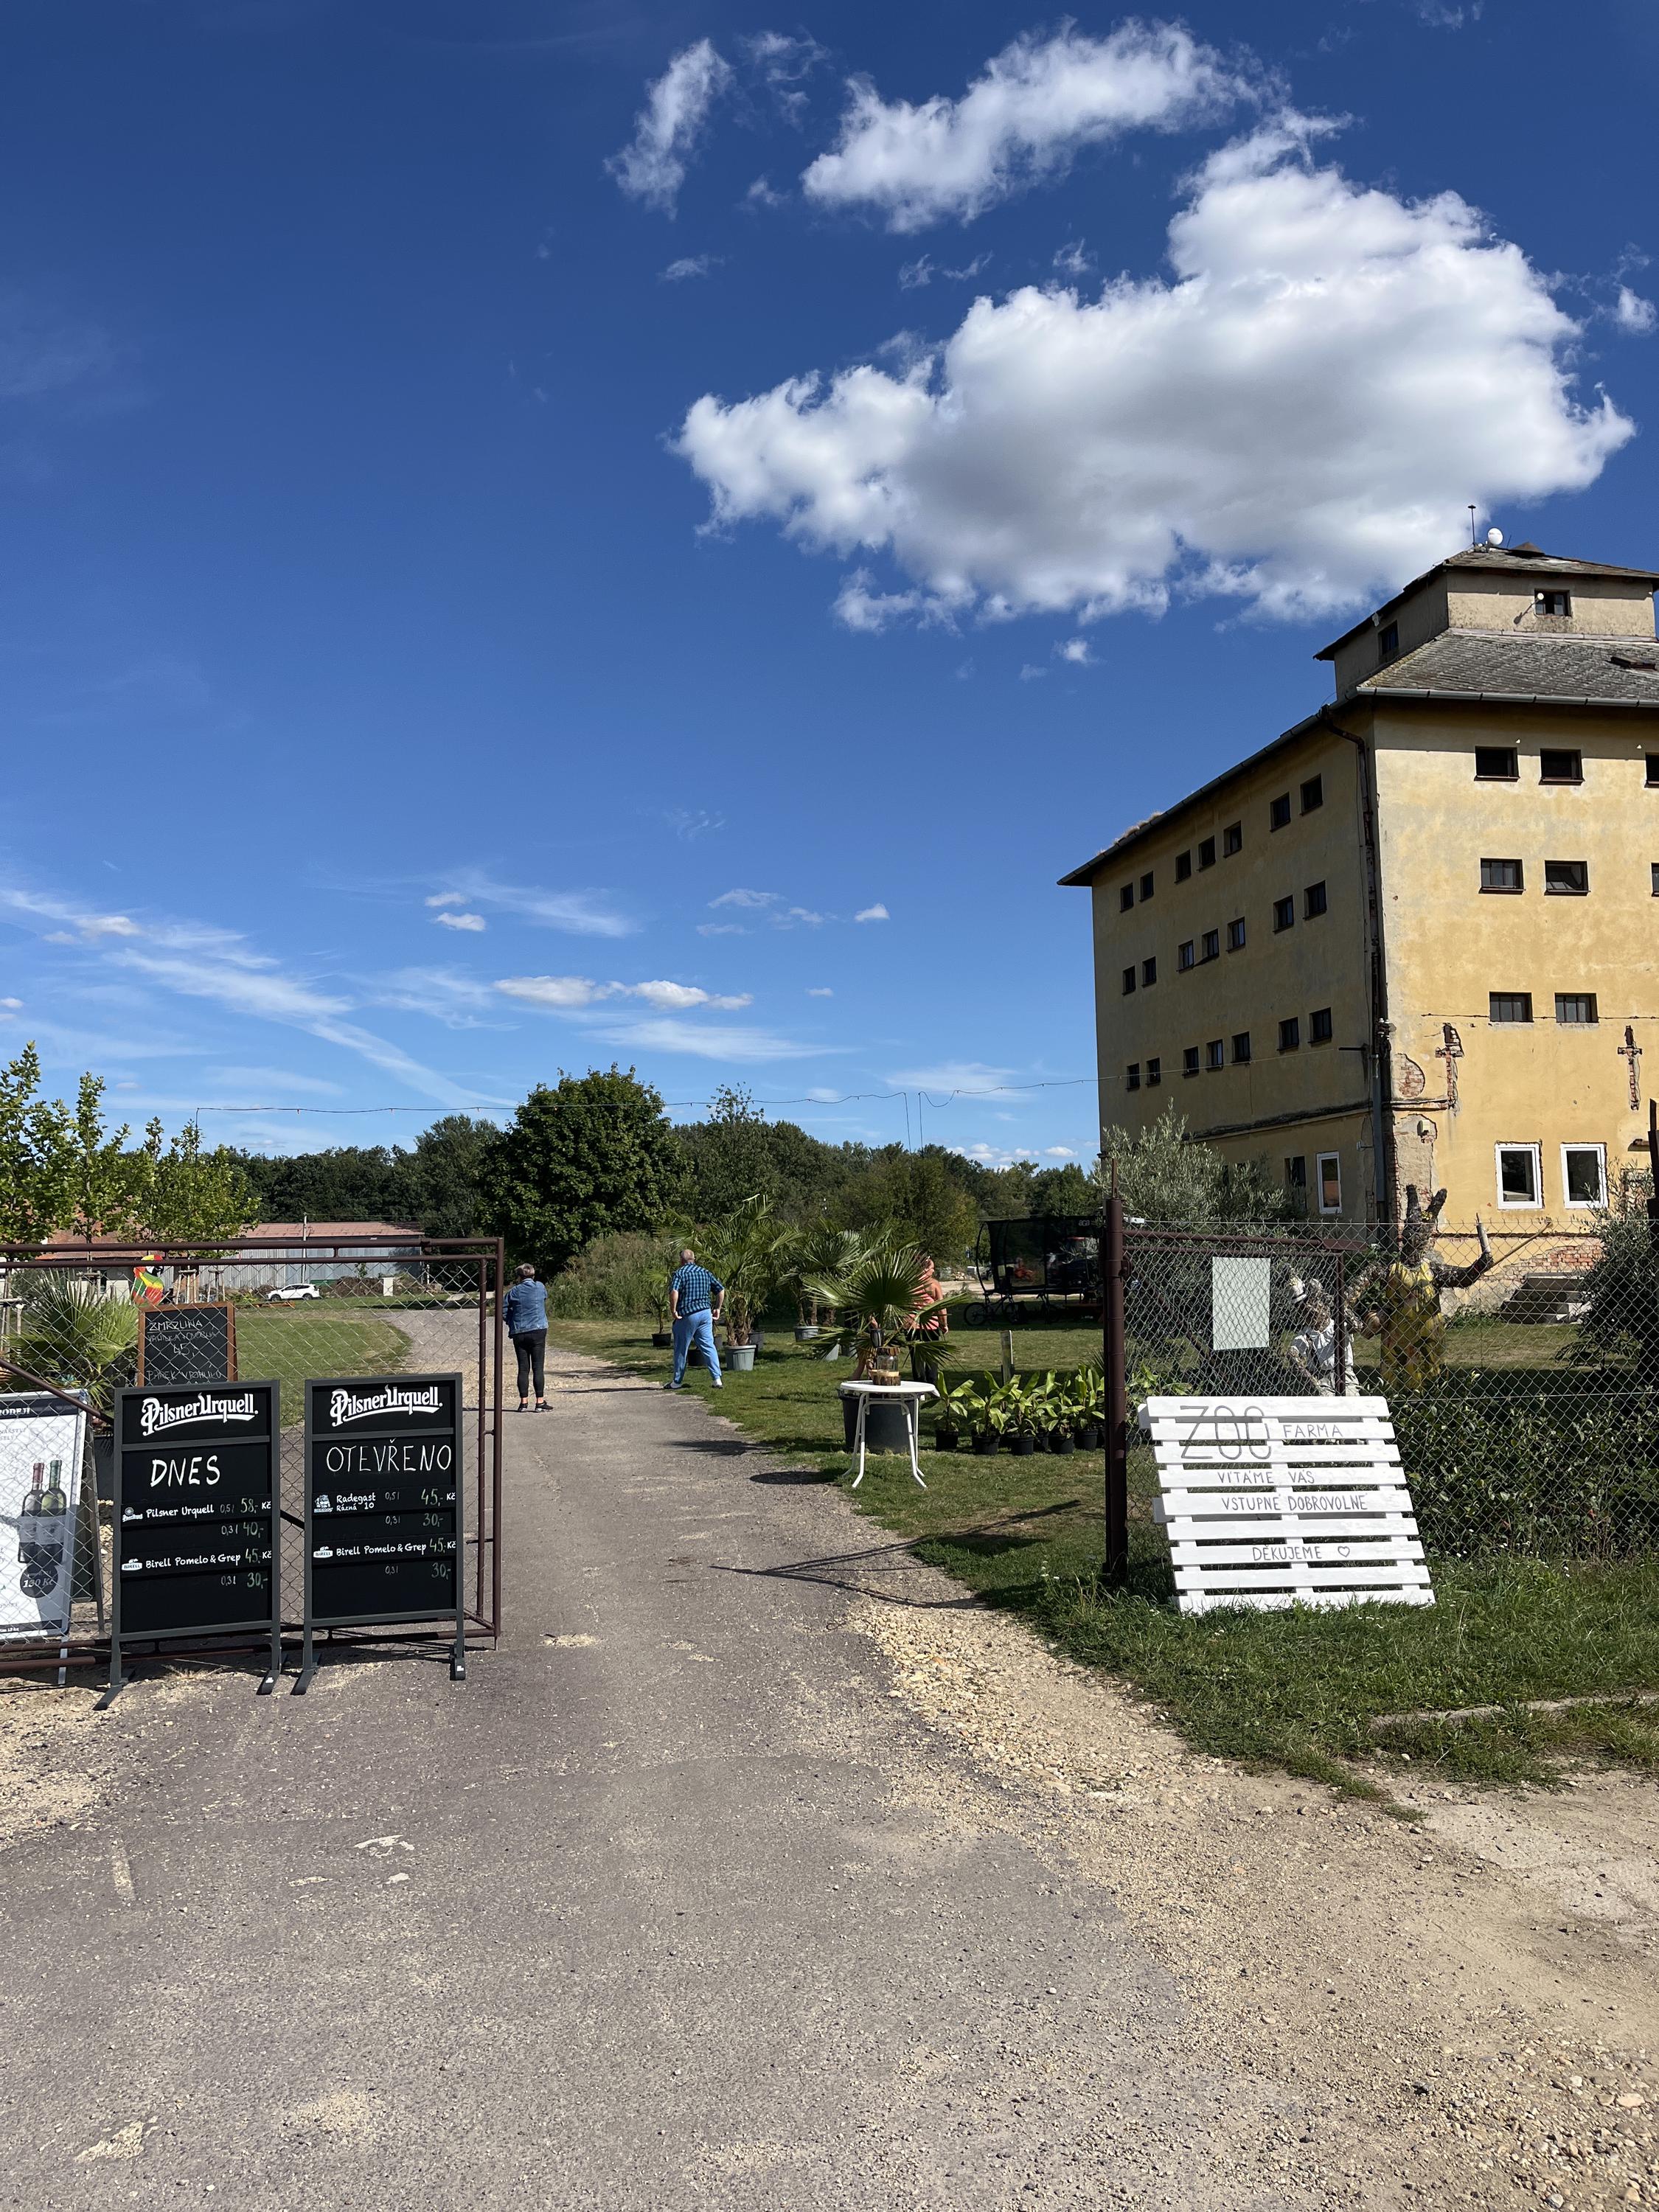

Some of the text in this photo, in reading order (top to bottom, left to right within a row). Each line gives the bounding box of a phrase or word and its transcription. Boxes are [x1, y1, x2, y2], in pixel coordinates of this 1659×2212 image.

[140, 1397, 200, 1436] Pilsner
[330, 1388, 387, 1427] Pilsner
[1180, 1405, 1343, 1461] ZOO FARMA
[326, 1438, 452, 1472] OTEVŘENO
[150, 1455, 220, 1487] DNES
[1288, 1470, 1315, 1484] VÁS
[336, 1492, 376, 1505] Radegast
[446, 1492, 456, 1500] Kč
[336, 1503, 358, 1512] Rázná
[364, 1501, 375, 1510] 10
[1221, 1492, 1368, 1511] VSTUPNÉ DOBROVOLNÉ
[146, 1508, 178, 1519] Pilsner
[181, 1503, 215, 1519] Urquell
[261, 1500, 271, 1510] Kč
[336, 1545, 361, 1557] Birell
[364, 1544, 396, 1554] Pomelo
[397, 1543, 403, 1553] &
[404, 1542, 427, 1555] Grep
[447, 1540, 456, 1549] Kč
[1253, 1544, 1323, 1562] DĚKUJEME
[145, 1557, 172, 1569] Birell
[175, 1555, 208, 1566] Pomelo
[209, 1555, 216, 1564] &
[218, 1554, 241, 1566] Grep
[262, 1550, 272, 1559] Kč
